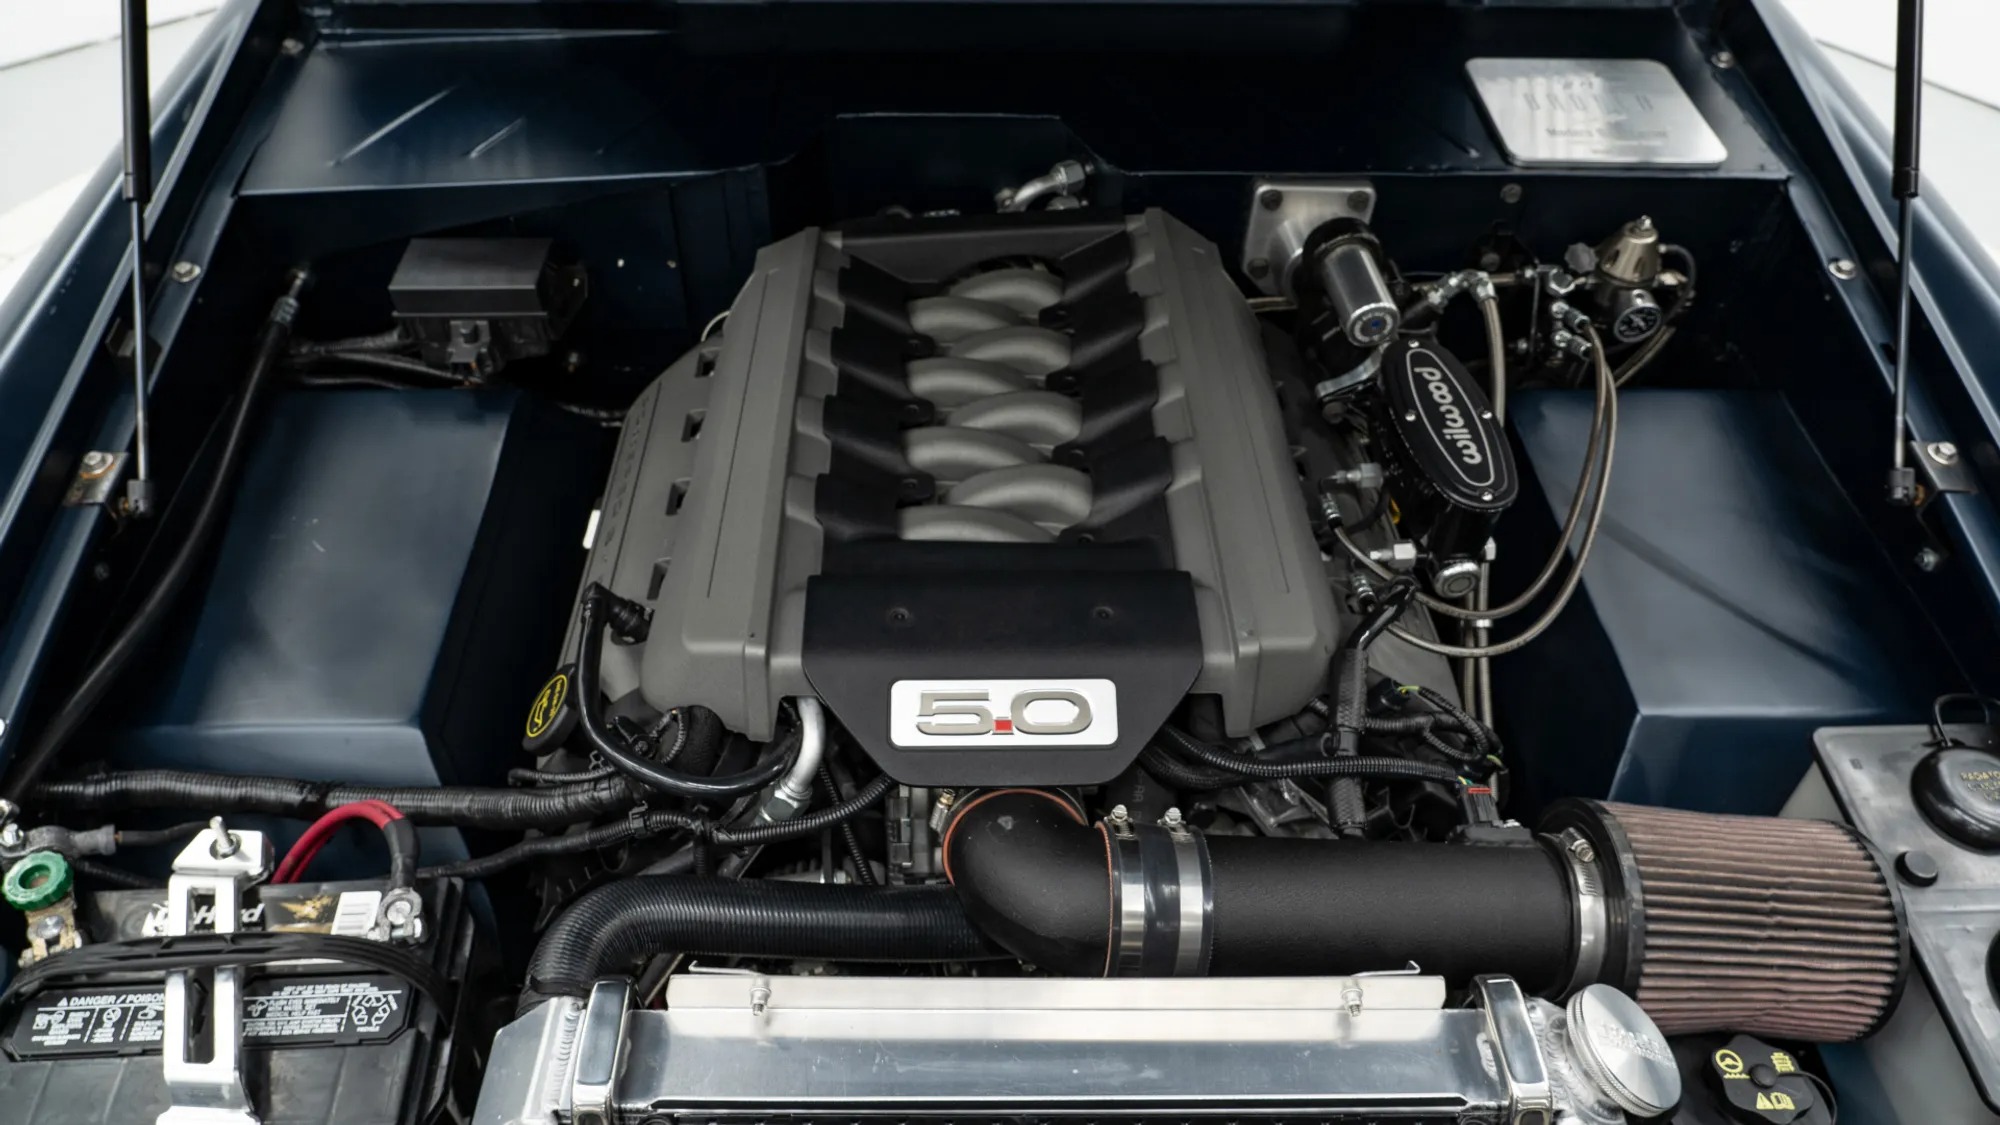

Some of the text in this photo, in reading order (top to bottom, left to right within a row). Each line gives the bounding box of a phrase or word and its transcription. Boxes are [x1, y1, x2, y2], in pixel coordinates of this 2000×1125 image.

[1414, 367, 1482, 464] wilwood
[916, 689, 1093, 736] 5.0
[70, 995, 116, 1006] DANGER
